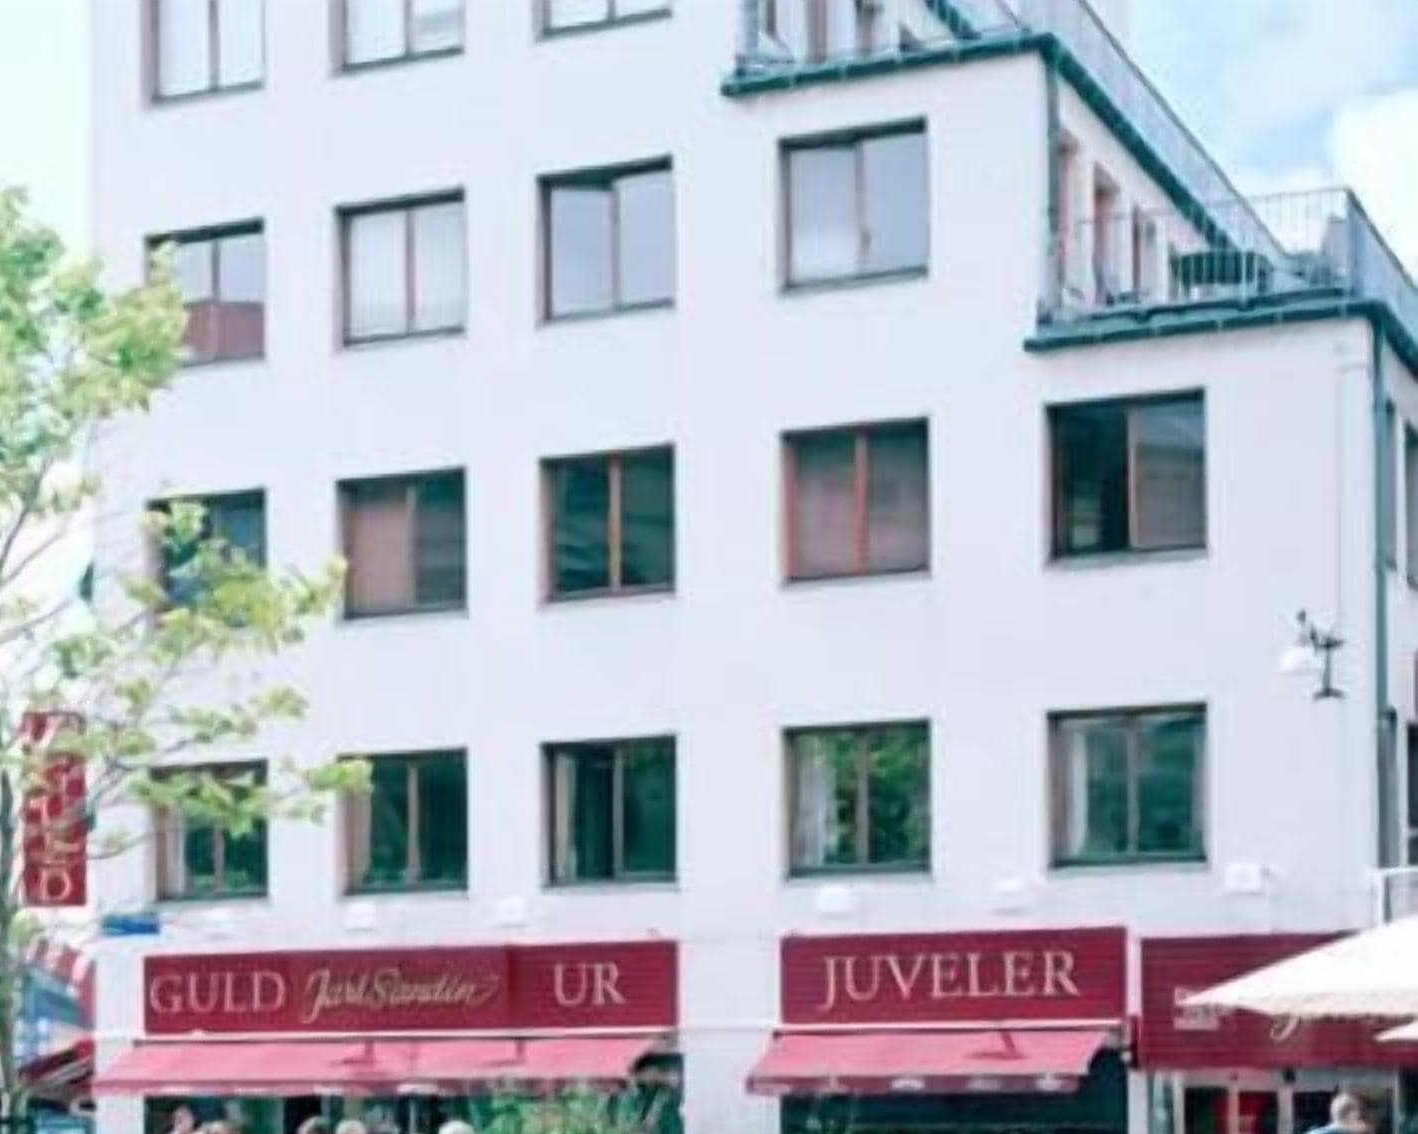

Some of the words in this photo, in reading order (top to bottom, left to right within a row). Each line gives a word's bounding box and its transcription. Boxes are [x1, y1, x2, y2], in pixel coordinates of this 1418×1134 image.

[149, 969, 286, 1014] GULD
[552, 962, 625, 1007] UR
[820, 949, 1080, 1013] JUVELER
